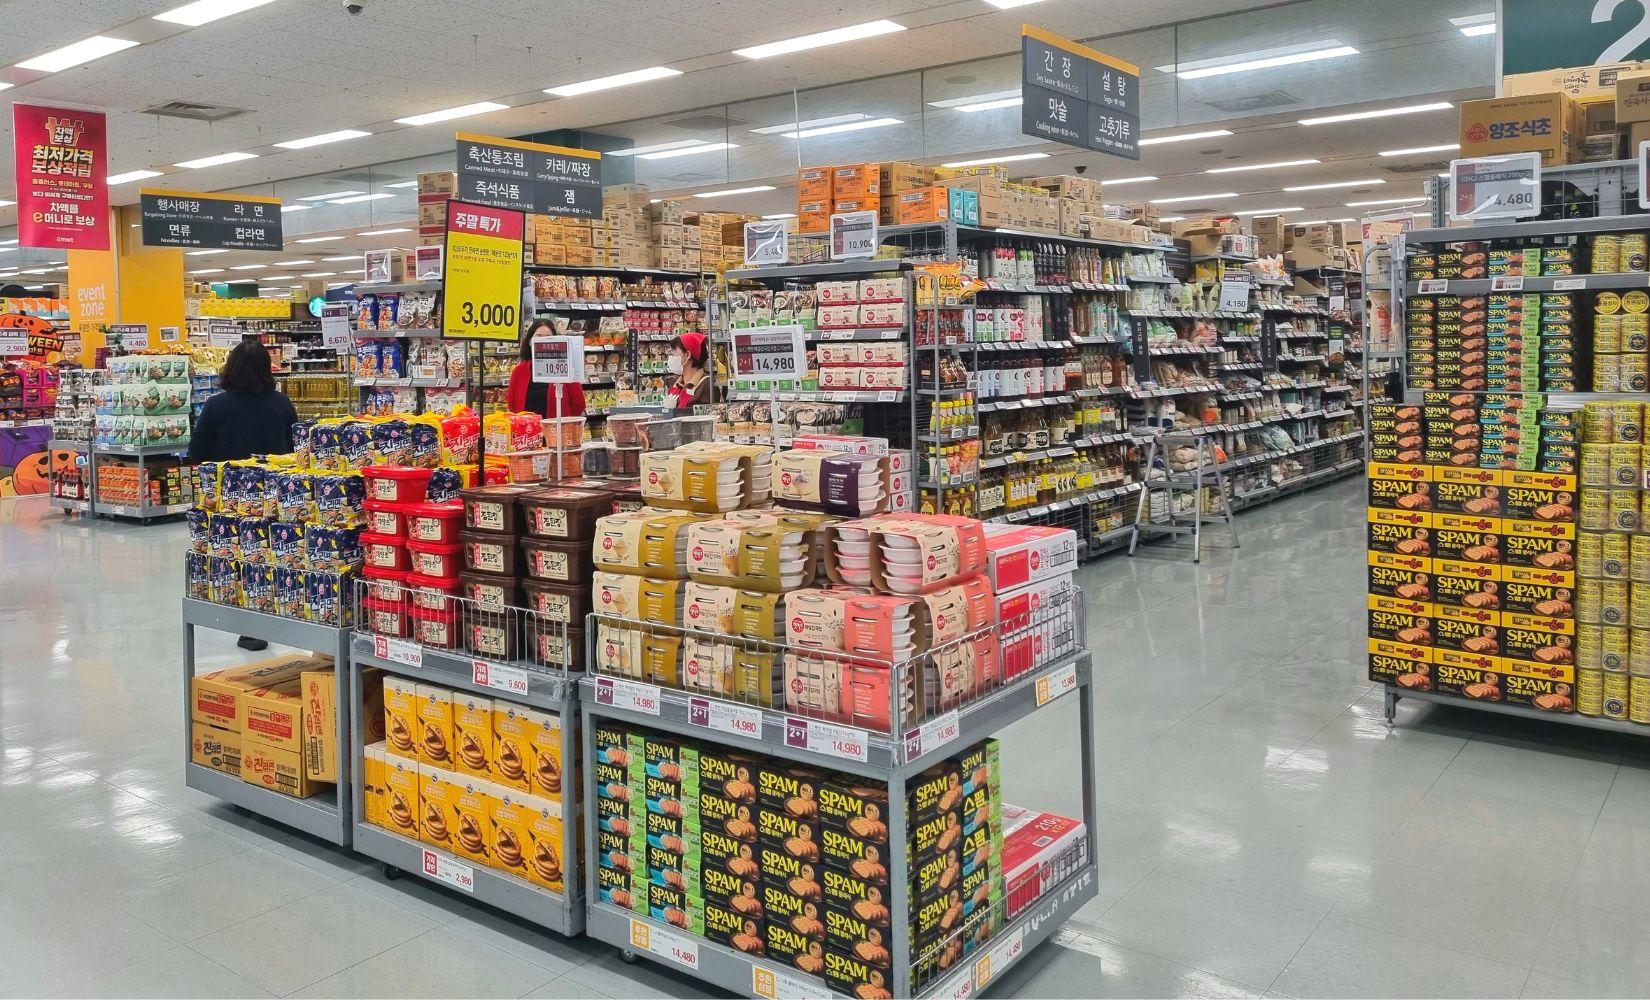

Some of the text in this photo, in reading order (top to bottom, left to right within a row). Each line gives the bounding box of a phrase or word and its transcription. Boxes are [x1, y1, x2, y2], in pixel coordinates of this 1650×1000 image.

[1591, 0, 1650, 65] 2
[1048, 97, 1067, 123] 맛술
[1099, 116, 1130, 140] 고춧가루
[1489, 118, 1551, 141] 양조식초
[54, 134, 73, 144] 보상
[32, 144, 94, 165] 최저가격
[468, 146, 524, 168] 축산통조림
[31, 159, 92, 179] 보상적립
[464, 164, 482, 172] Canned
[546, 158, 591, 177] 카레/짜장
[475, 180, 520, 199] 즉석식품
[564, 189, 575, 204] 잼
[157, 198, 200, 213] 행사매장
[1487, 192, 1532, 206] 4,480
[50, 202, 79, 214] 차액을
[75, 215, 95, 226] 보상
[455, 212, 501, 233] 주말 특가
[169, 223, 191, 236] 면류
[235, 227, 265, 241] 컵라면
[1438, 253, 1461, 262] SPAM
[1547, 249, 1569, 257] SPAM
[77, 284, 106, 302] event
[80, 302, 105, 318] zone
[1226, 300, 1247, 308] 4,150
[461, 301, 515, 328] 3,000
[6, 345, 27, 353] 2,980
[328, 337, 348, 345] 6,670
[546, 363, 569, 374] 10,900
[755, 357, 795, 371] 14,980
[1437, 364, 1460, 373] SPAM
[1424, 392, 1450, 401] SPAM
[1373, 406, 1396, 415] SPAM
[1429, 421, 1454, 430] SPAM
[1483, 424, 1508, 432] SPAM
[1374, 434, 1398, 443] SPAM
[1373, 448, 1397, 457] SPAM
[1372, 480, 1413, 494] SPAM
[1438, 483, 1482, 498] SPAM
[1508, 488, 1554, 504] SPAM
[1372, 524, 1412, 539] SPAM
[1507, 537, 1553, 553] SPAM
[1437, 577, 1480, 593] SPAM
[1372, 612, 1413, 628] SPAM
[1372, 656, 1413, 673] SPAM
[1438, 666, 1481, 684] SPAM
[599, 688, 612, 698] 2+1
[1506, 676, 1552, 694] SPAM
[632, 696, 655, 710] 14,980
[692, 706, 707, 718] 2+1
[730, 718, 757, 733] 14,980
[789, 727, 805, 741] 2+1
[646, 742, 674, 760] SPAM
[832, 740, 861, 756] 14,980
[700, 756, 735, 778] SPAM
[962, 752, 984, 773] SPAM
[647, 779, 675, 796] SPAM
[759, 771, 799, 796] SPAM
[916, 776, 948, 803] SPAM
[819, 789, 863, 815] SPAM
[963, 788, 986, 818] 스팸
[759, 810, 797, 836] SPAM
[916, 815, 947, 844] SPAM
[823, 830, 863, 857] SPAM
[963, 827, 986, 857] 스팸
[651, 848, 677, 867] SPAM
[920, 854, 947, 884] SPAM
[705, 868, 741, 894] SPAM
[963, 867, 985, 893] SPAM
[650, 886, 679, 906] SPAM
[919, 895, 949, 925] SPAM
[706, 906, 742, 931] SPAM
[768, 925, 807, 952] SPAM
[671, 947, 696, 964] 14,480
[825, 952, 868, 981] SPAM
